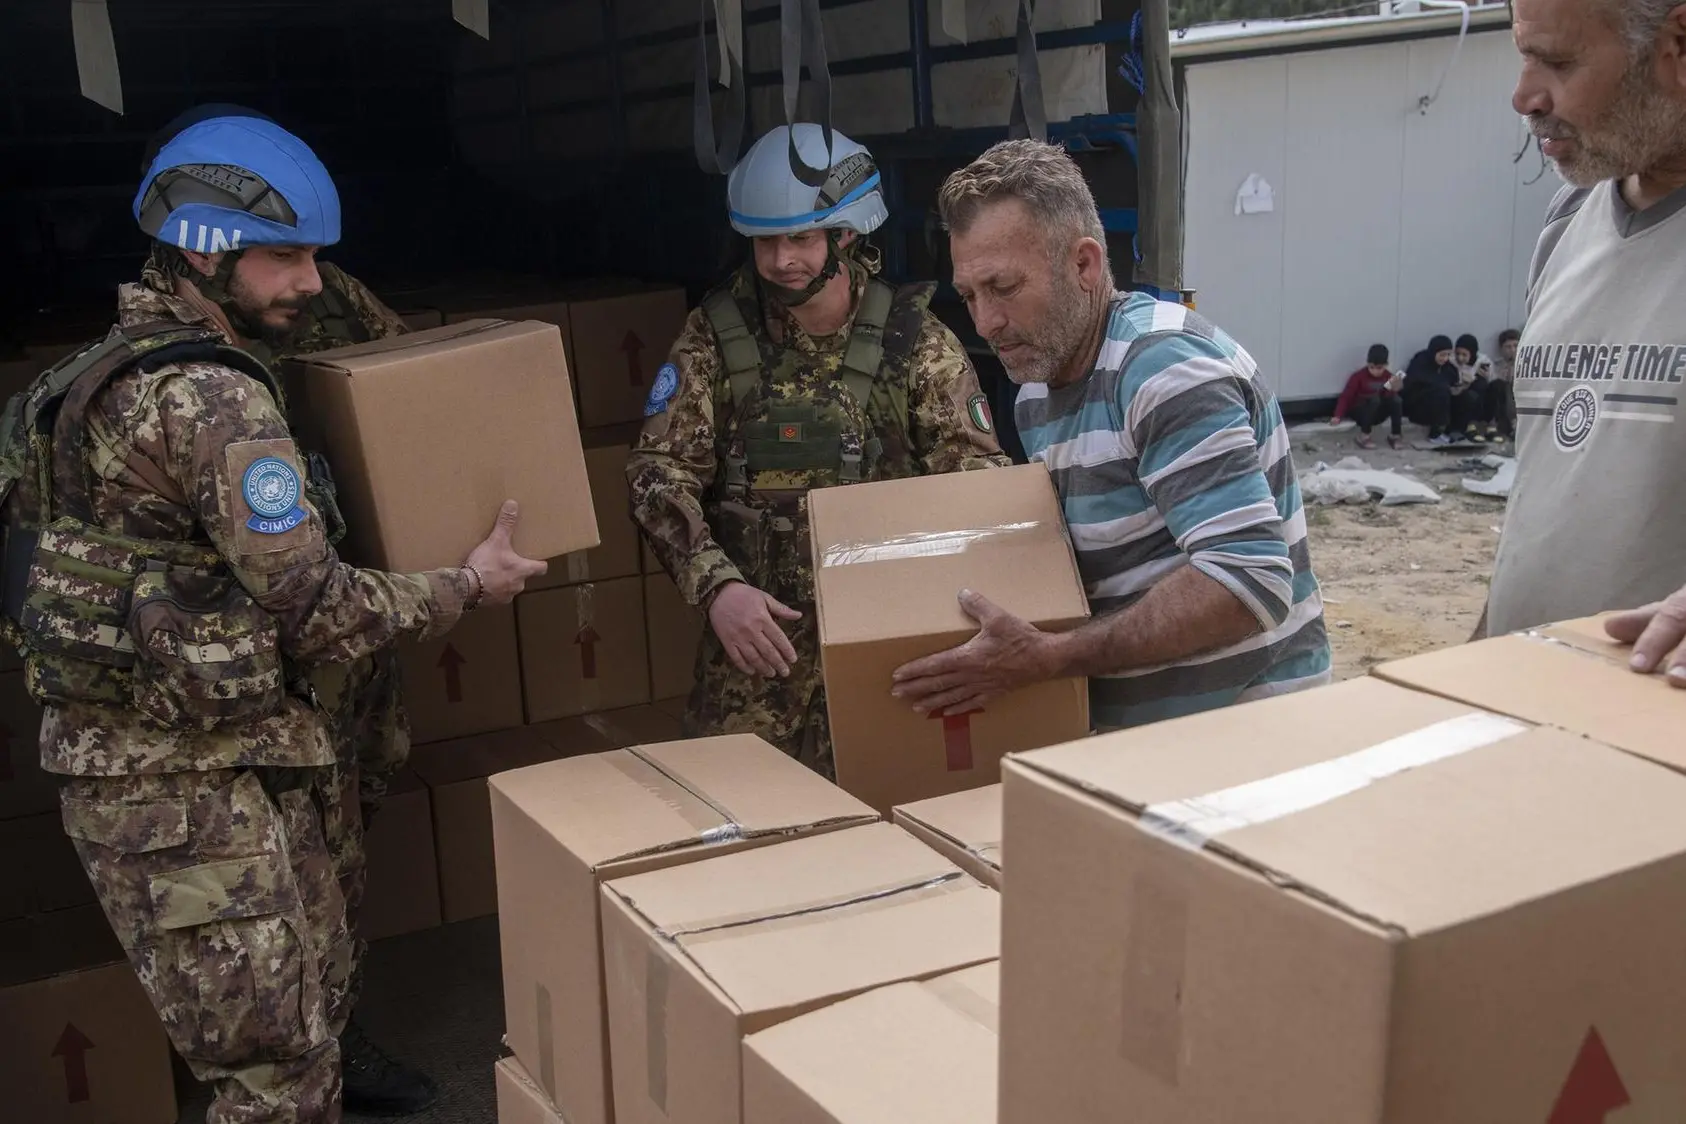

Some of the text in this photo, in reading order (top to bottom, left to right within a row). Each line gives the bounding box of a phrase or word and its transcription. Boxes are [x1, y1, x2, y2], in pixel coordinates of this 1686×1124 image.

[178, 220, 241, 252] UN
[1516, 344, 1686, 382] CHALLENGE TIME
[1557, 394, 1574, 426] UNIQUE
[250, 464, 292, 486] UNITED NATIONS
[252, 494, 282, 511] NATIONS
[260, 516, 296, 531] CIMIC
